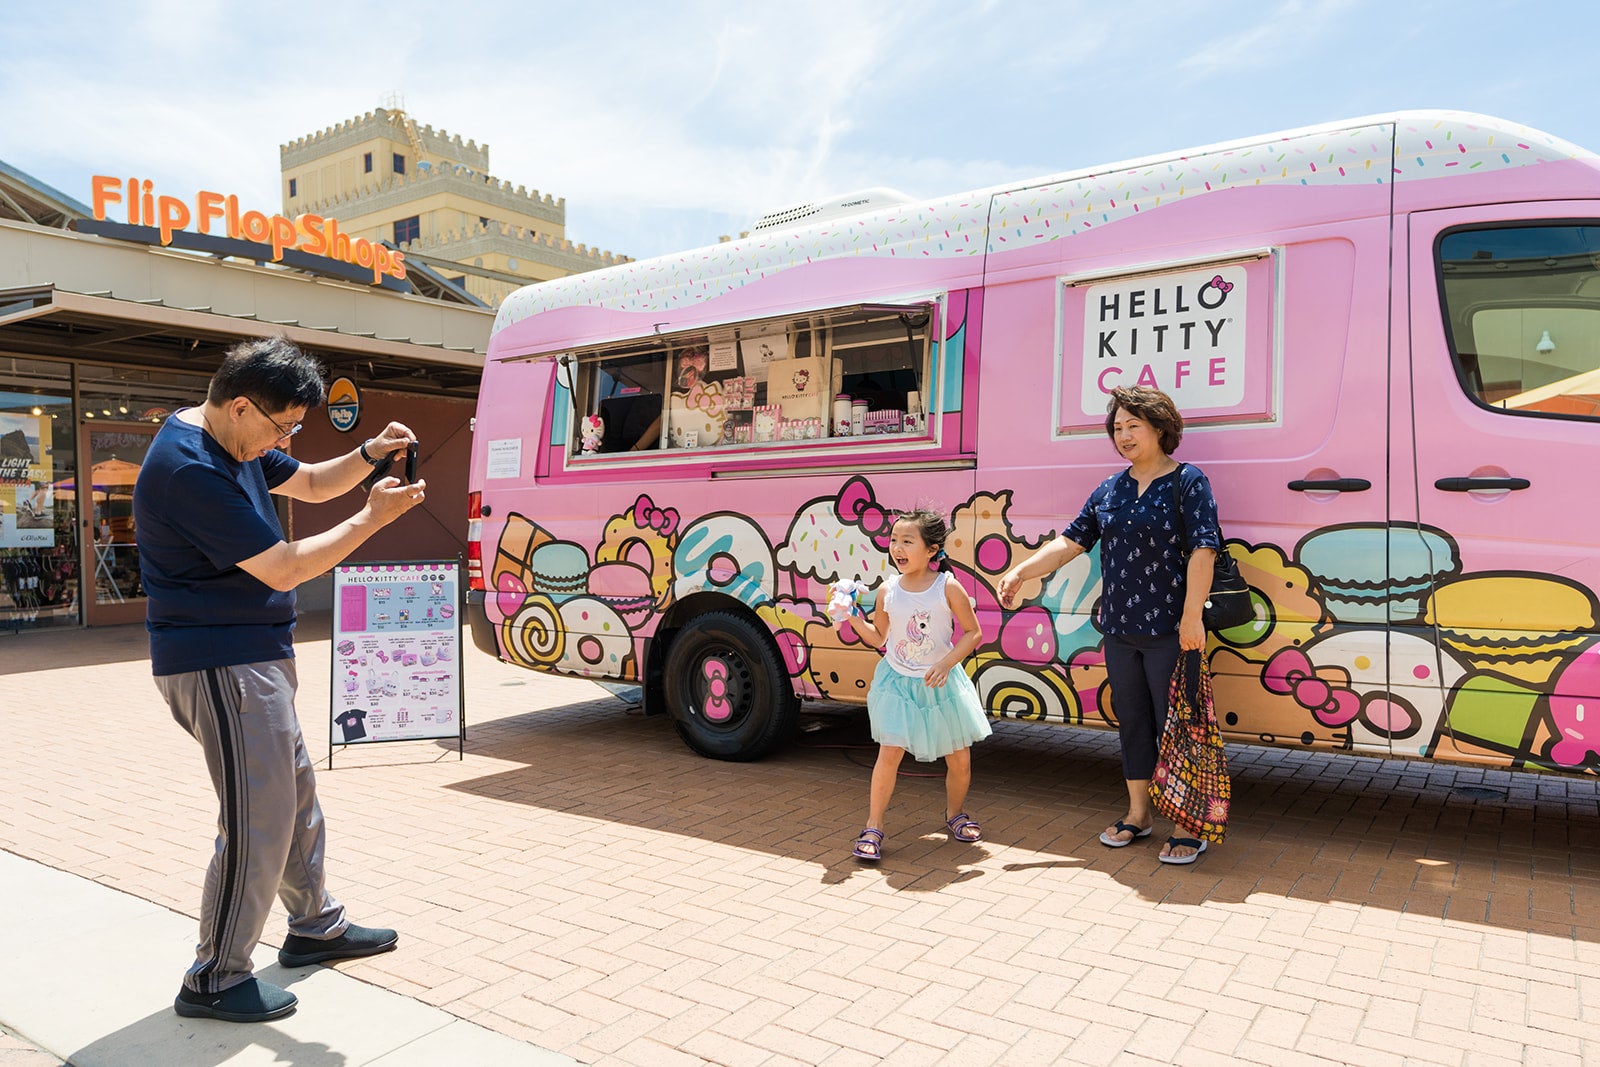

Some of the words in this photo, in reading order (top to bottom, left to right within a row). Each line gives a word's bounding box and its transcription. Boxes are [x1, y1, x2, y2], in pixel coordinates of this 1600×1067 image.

[92, 175, 191, 246] Flip
[1099, 276, 1232, 322] HELLO
[1097, 357, 1226, 395] CAFE
